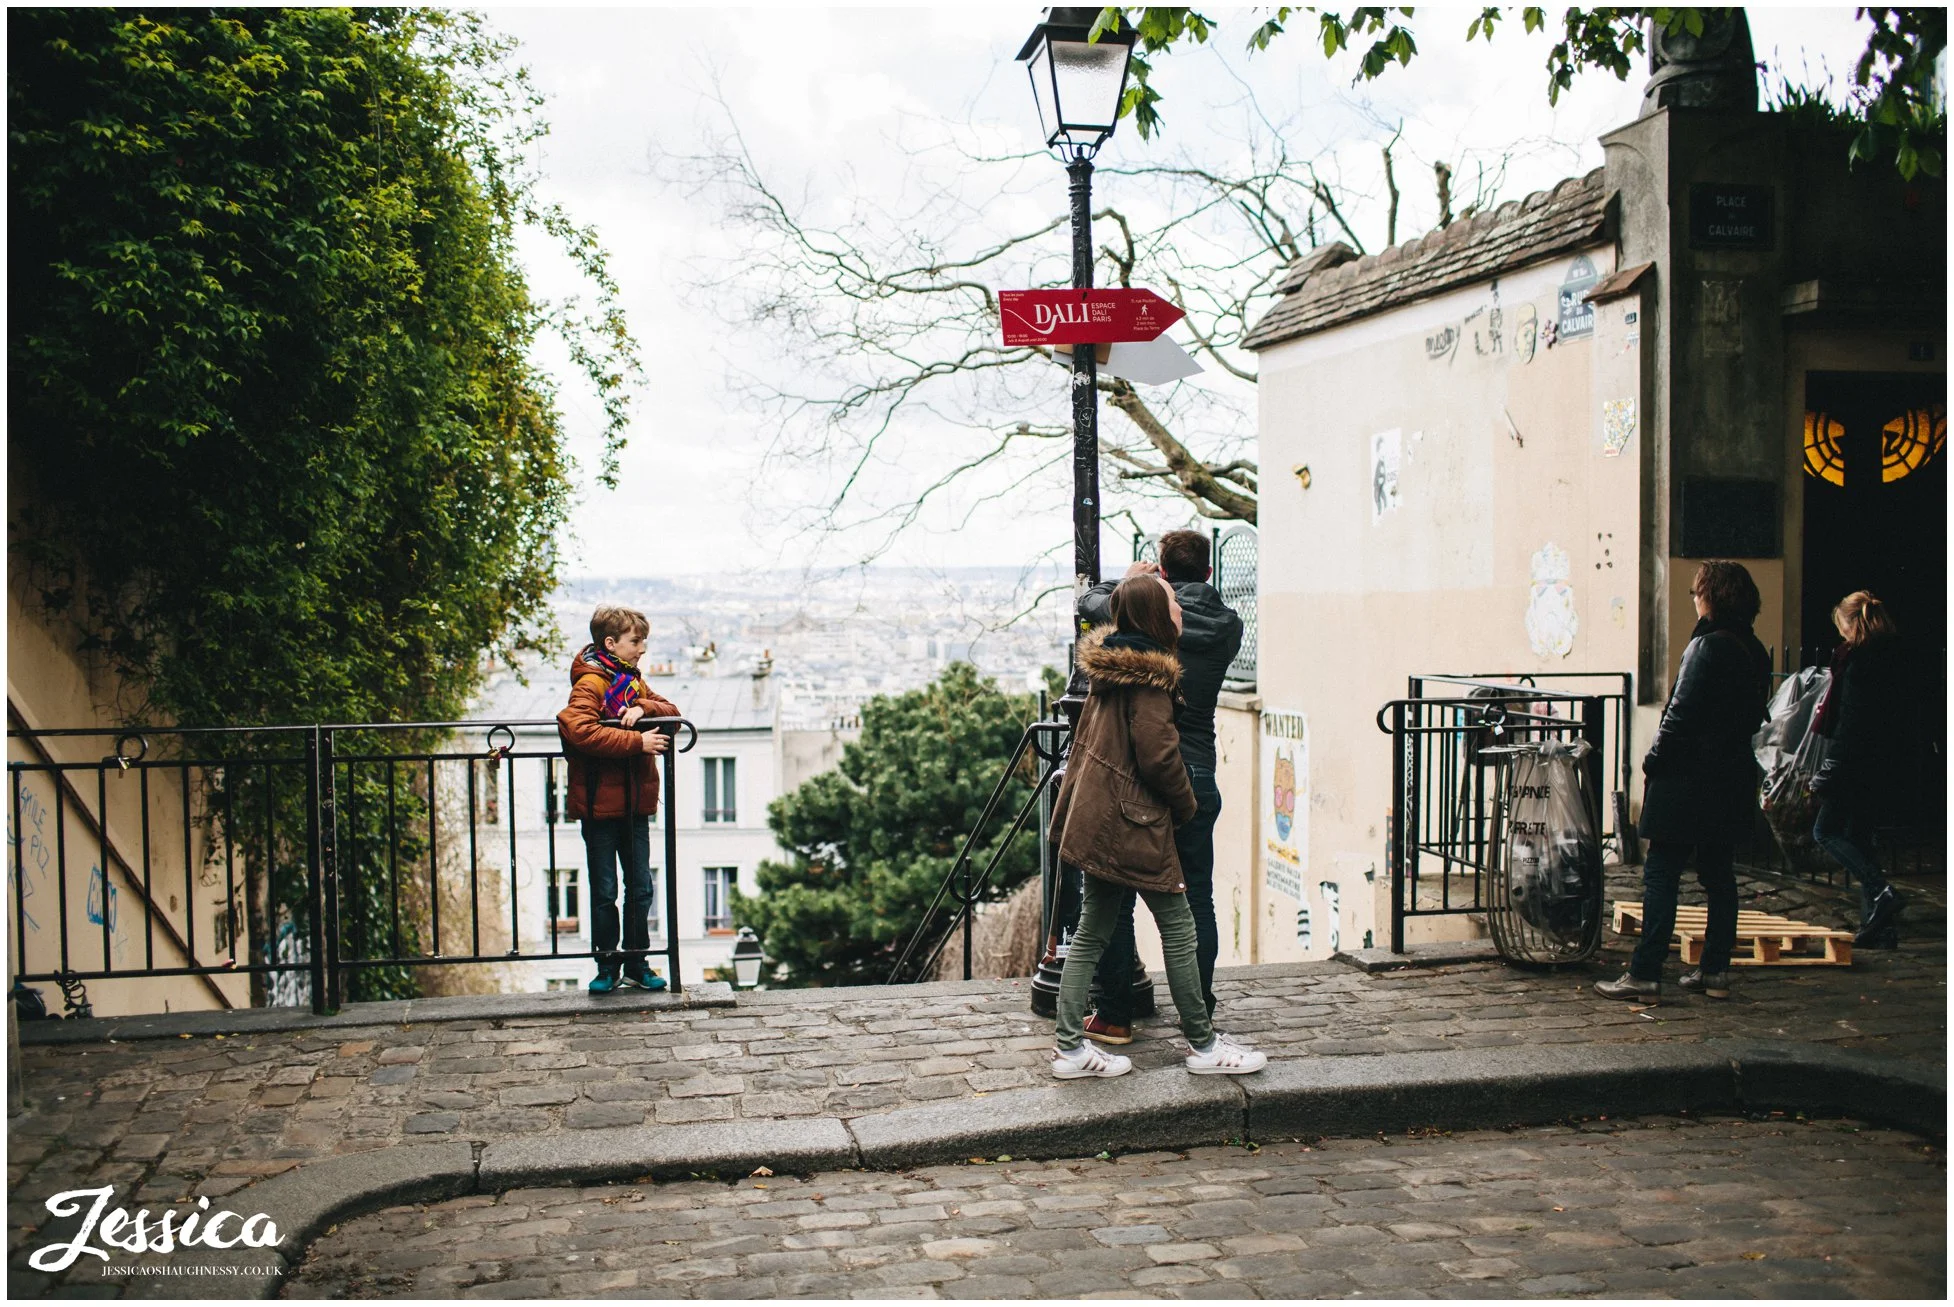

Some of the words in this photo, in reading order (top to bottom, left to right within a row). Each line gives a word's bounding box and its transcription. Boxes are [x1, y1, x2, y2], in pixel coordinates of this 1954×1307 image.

[1716, 196, 1747, 208] PLACE
[1708, 224, 1756, 237] CALVAIRE
[1562, 314, 1593, 334] CALVAIR
[1264, 712, 1304, 740] WANTED
